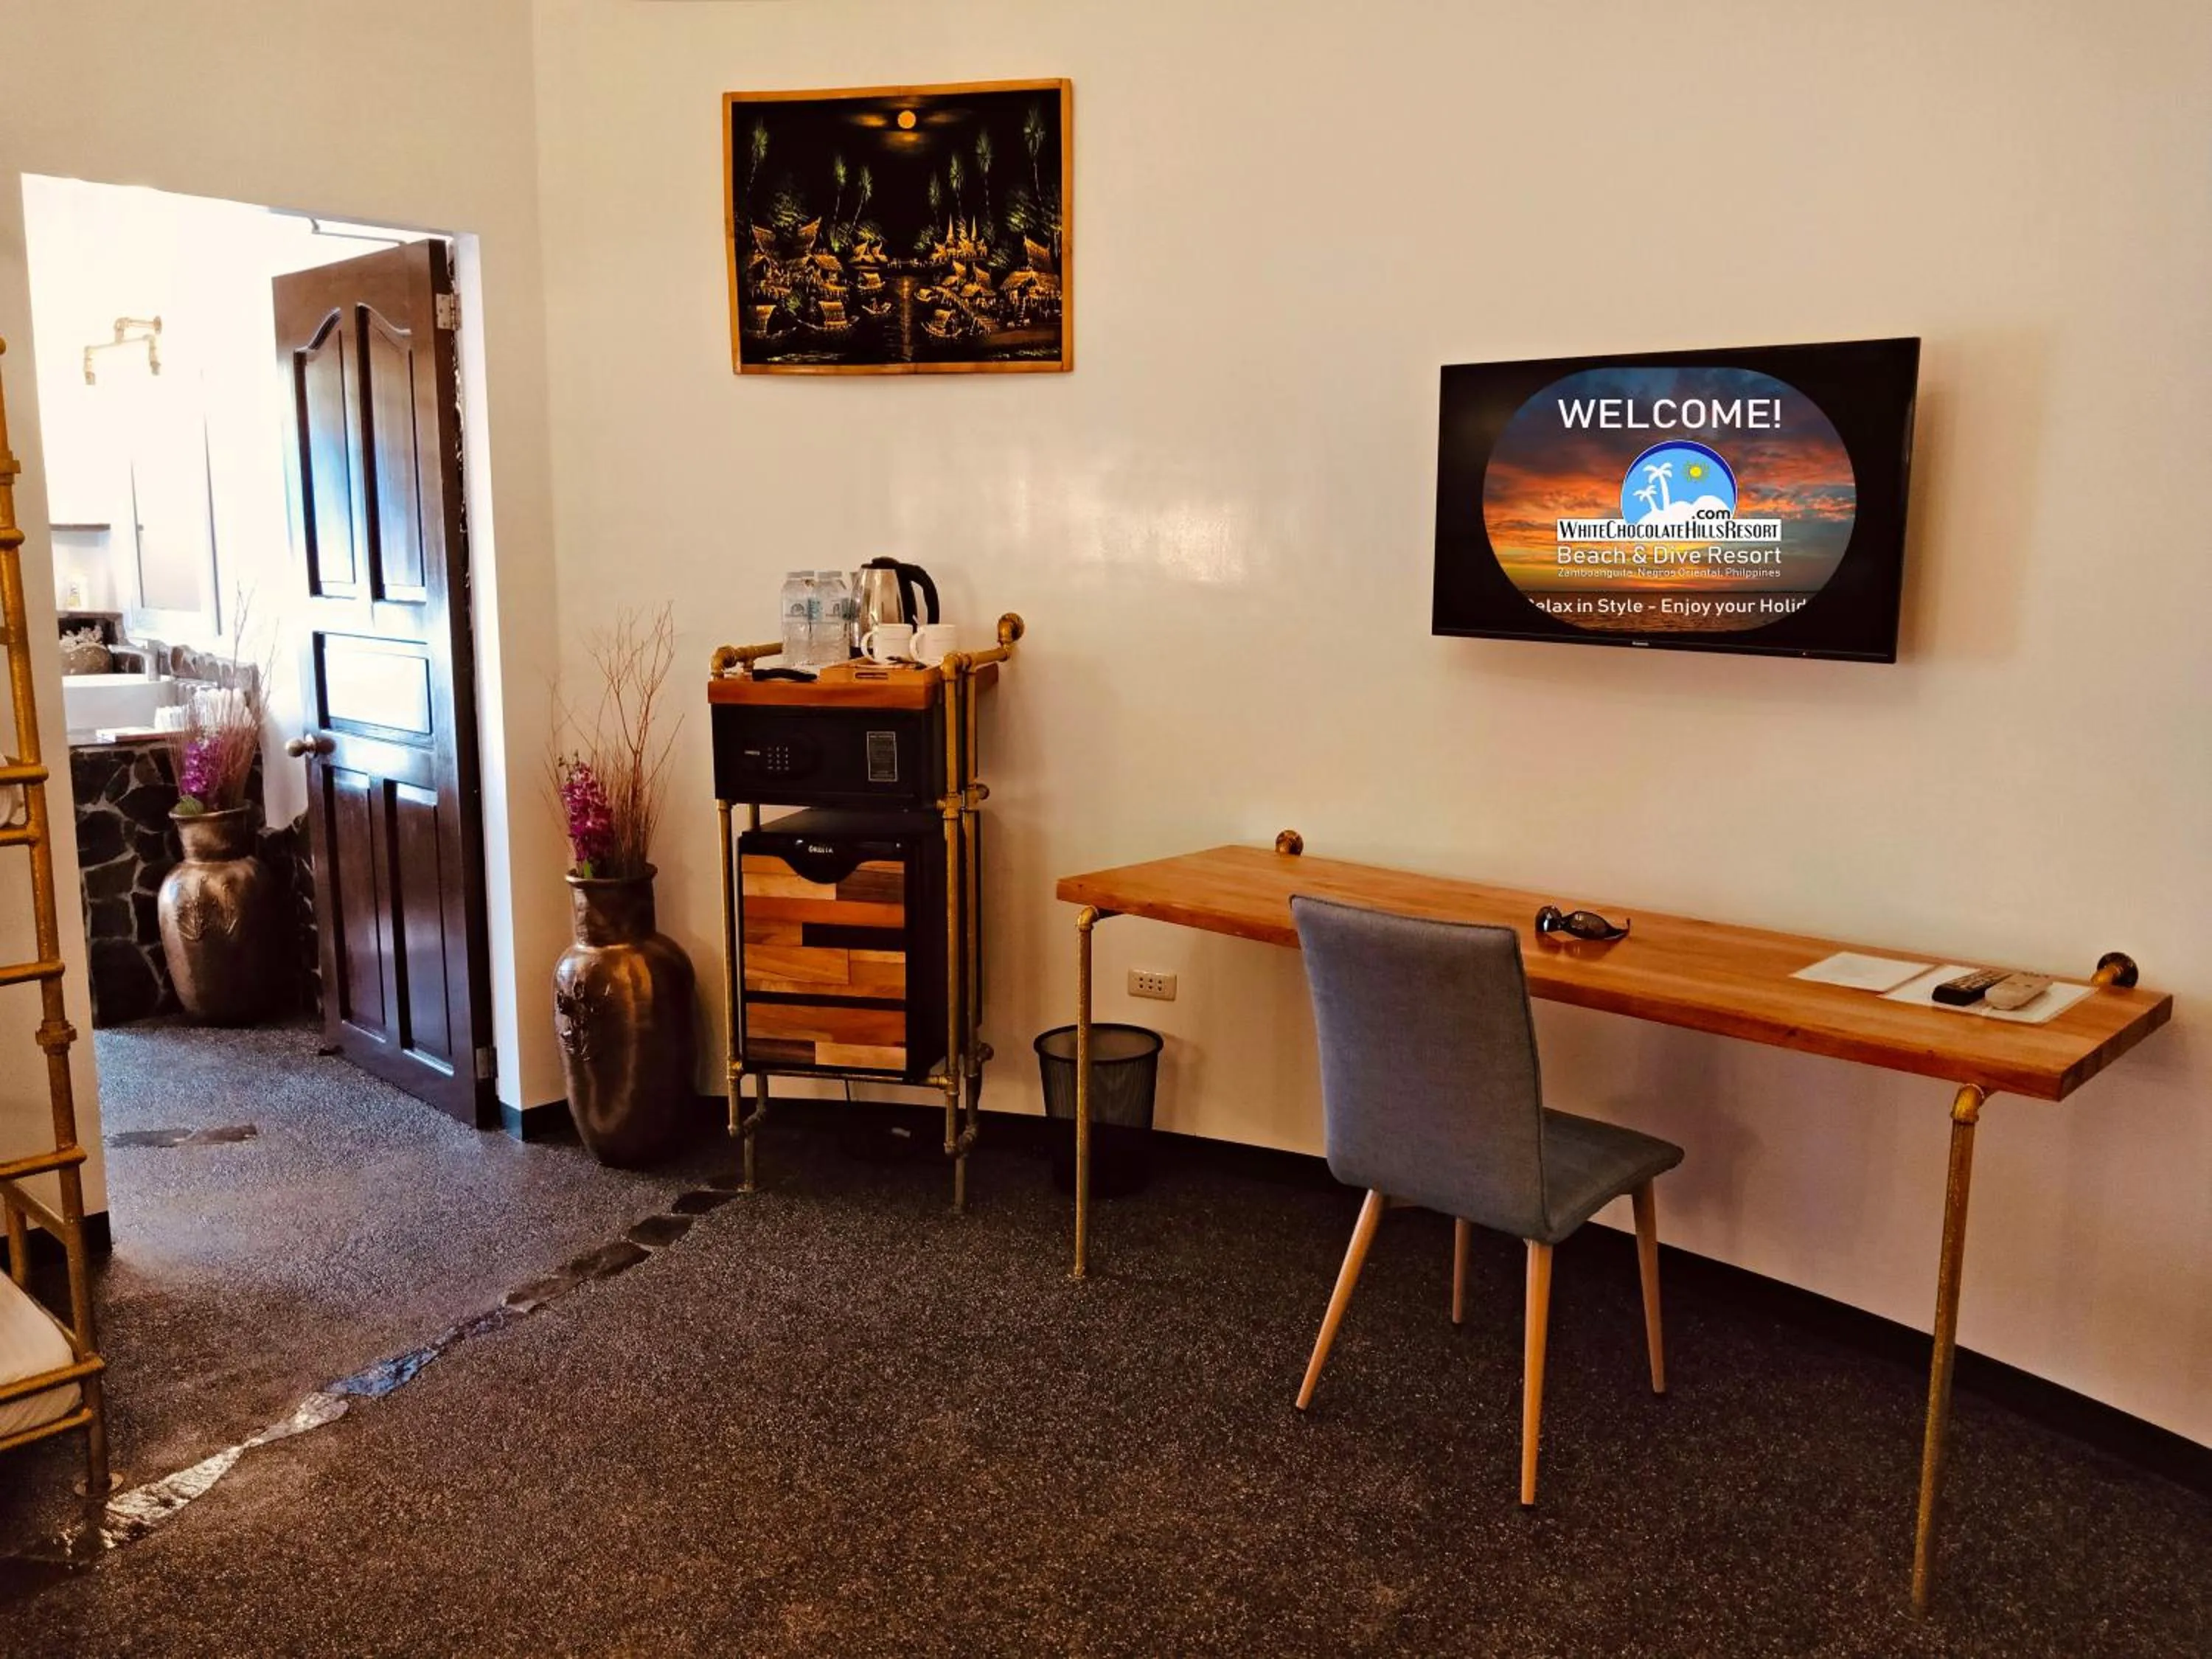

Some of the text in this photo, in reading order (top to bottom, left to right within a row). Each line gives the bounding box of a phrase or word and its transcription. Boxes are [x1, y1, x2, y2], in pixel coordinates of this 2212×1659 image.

[1557, 399, 1781, 429] WELCOME!
[1691, 509, 1731, 520] .com
[1557, 545, 1782, 564] Beach & Dive Resort
[1528, 598, 1573, 613] elax
[1577, 598, 1593, 613] in
[1598, 598, 1644, 616] Style
[1661, 598, 1711, 616] Enjoy
[1714, 602, 1756, 616] your
